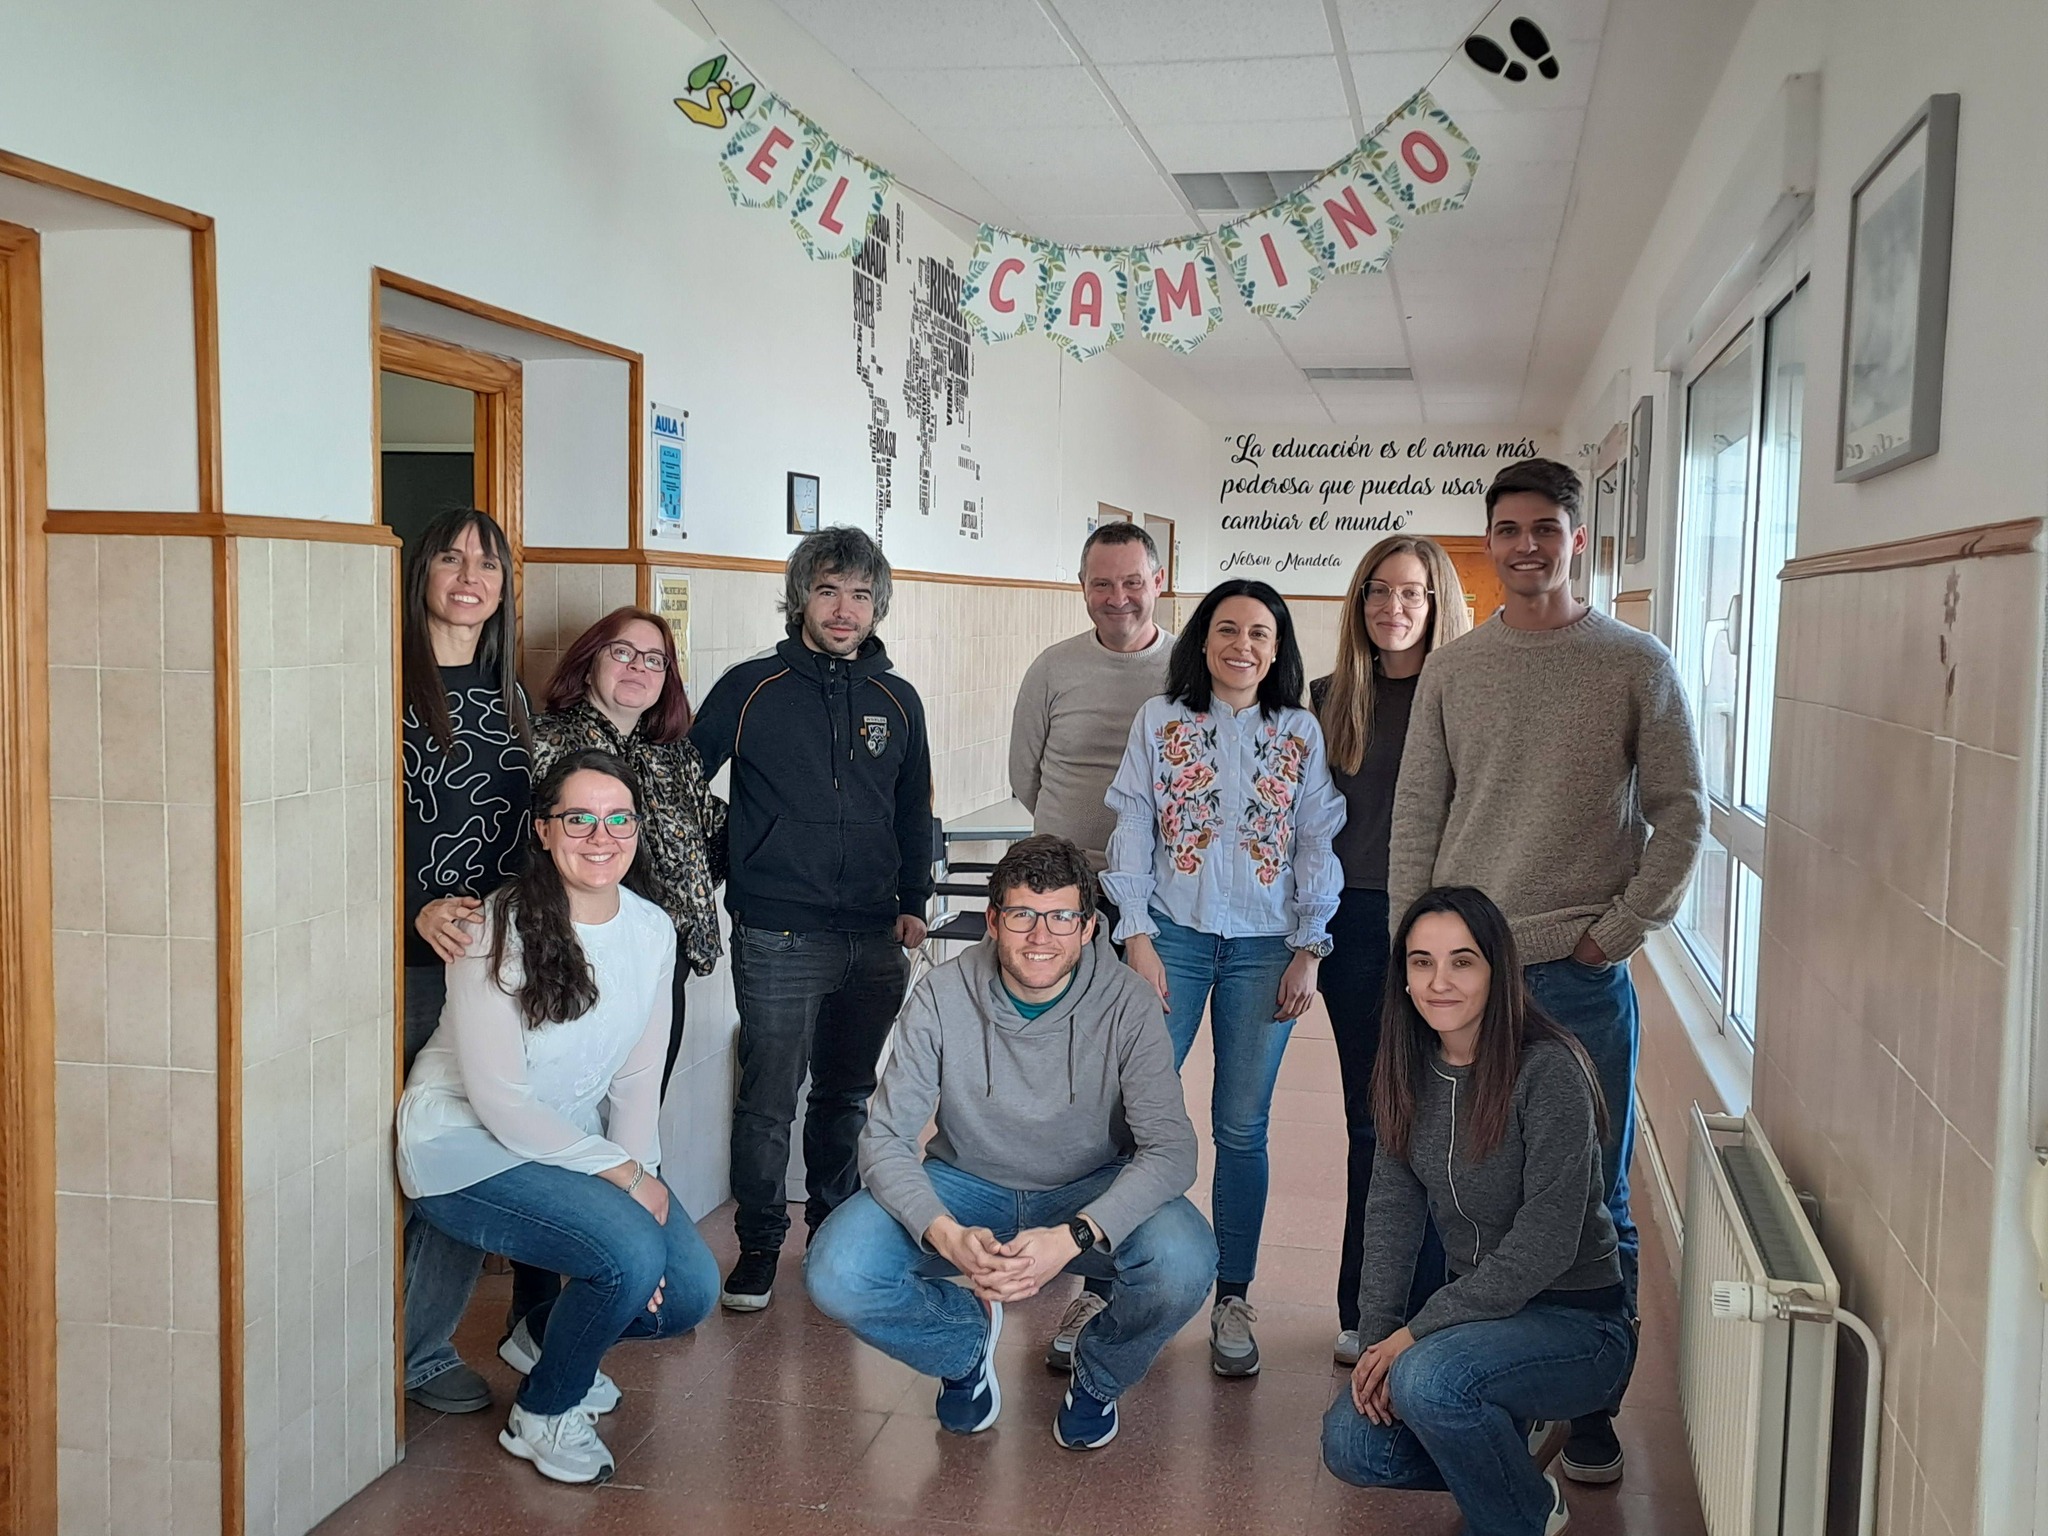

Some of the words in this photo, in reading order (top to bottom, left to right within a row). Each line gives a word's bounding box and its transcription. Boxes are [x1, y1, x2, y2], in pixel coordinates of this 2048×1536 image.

[746, 125, 850, 235] EL
[989, 130, 1450, 328] CAMINO
[948, 336, 969, 381] CHINA
[655, 415, 679, 436] AULA
[680, 421, 685, 438] 1
[877, 427, 898, 460] BRASIL
[1272, 435, 1373, 459] educación
[1380, 442, 1401, 458] es
[1407, 437, 1427, 458] el
[1433, 442, 1490, 459] arma
[1497, 437, 1540, 458] más
[1220, 473, 1314, 504] poderosa
[1319, 478, 1356, 505] que
[1360, 474, 1436, 505] puedas
[1442, 477, 1488, 496] usar
[1221, 509, 1303, 531] cambiar
[1309, 510, 1329, 531] el
[1220, 551, 1272, 571] Nelson
[1275, 551, 1343, 572] Mandela
